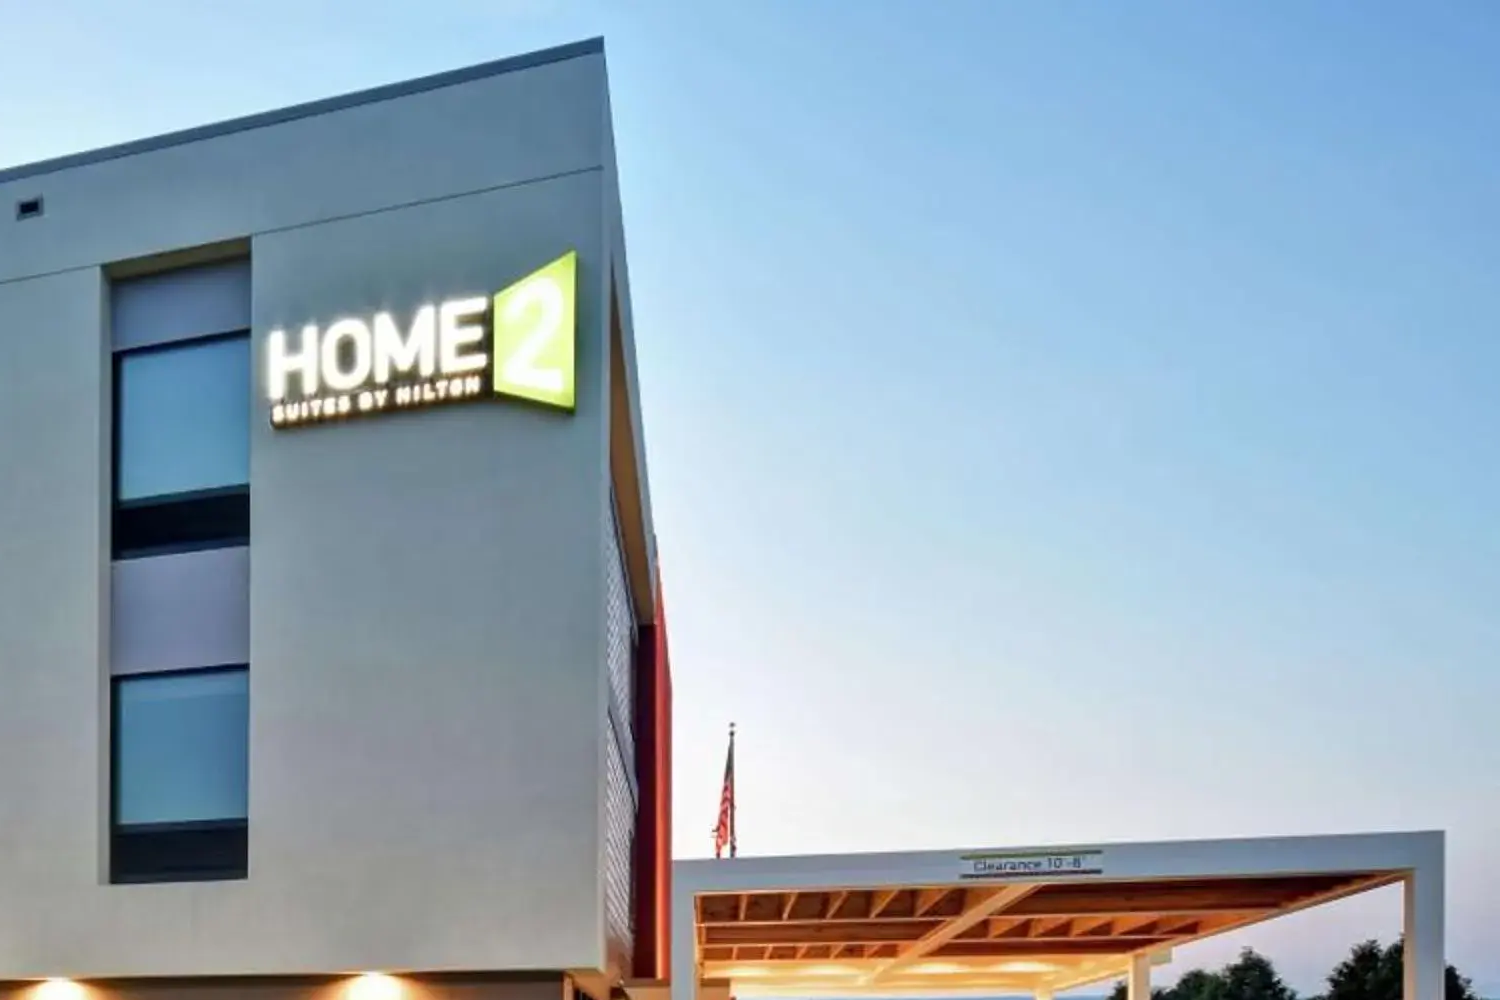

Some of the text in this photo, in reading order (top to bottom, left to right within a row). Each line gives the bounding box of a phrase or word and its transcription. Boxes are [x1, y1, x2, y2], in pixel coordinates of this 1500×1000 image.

[268, 276, 565, 400] HOME 2
[271, 375, 481, 424] SUITES BY HILTON
[973, 859, 1042, 872] Clearance
